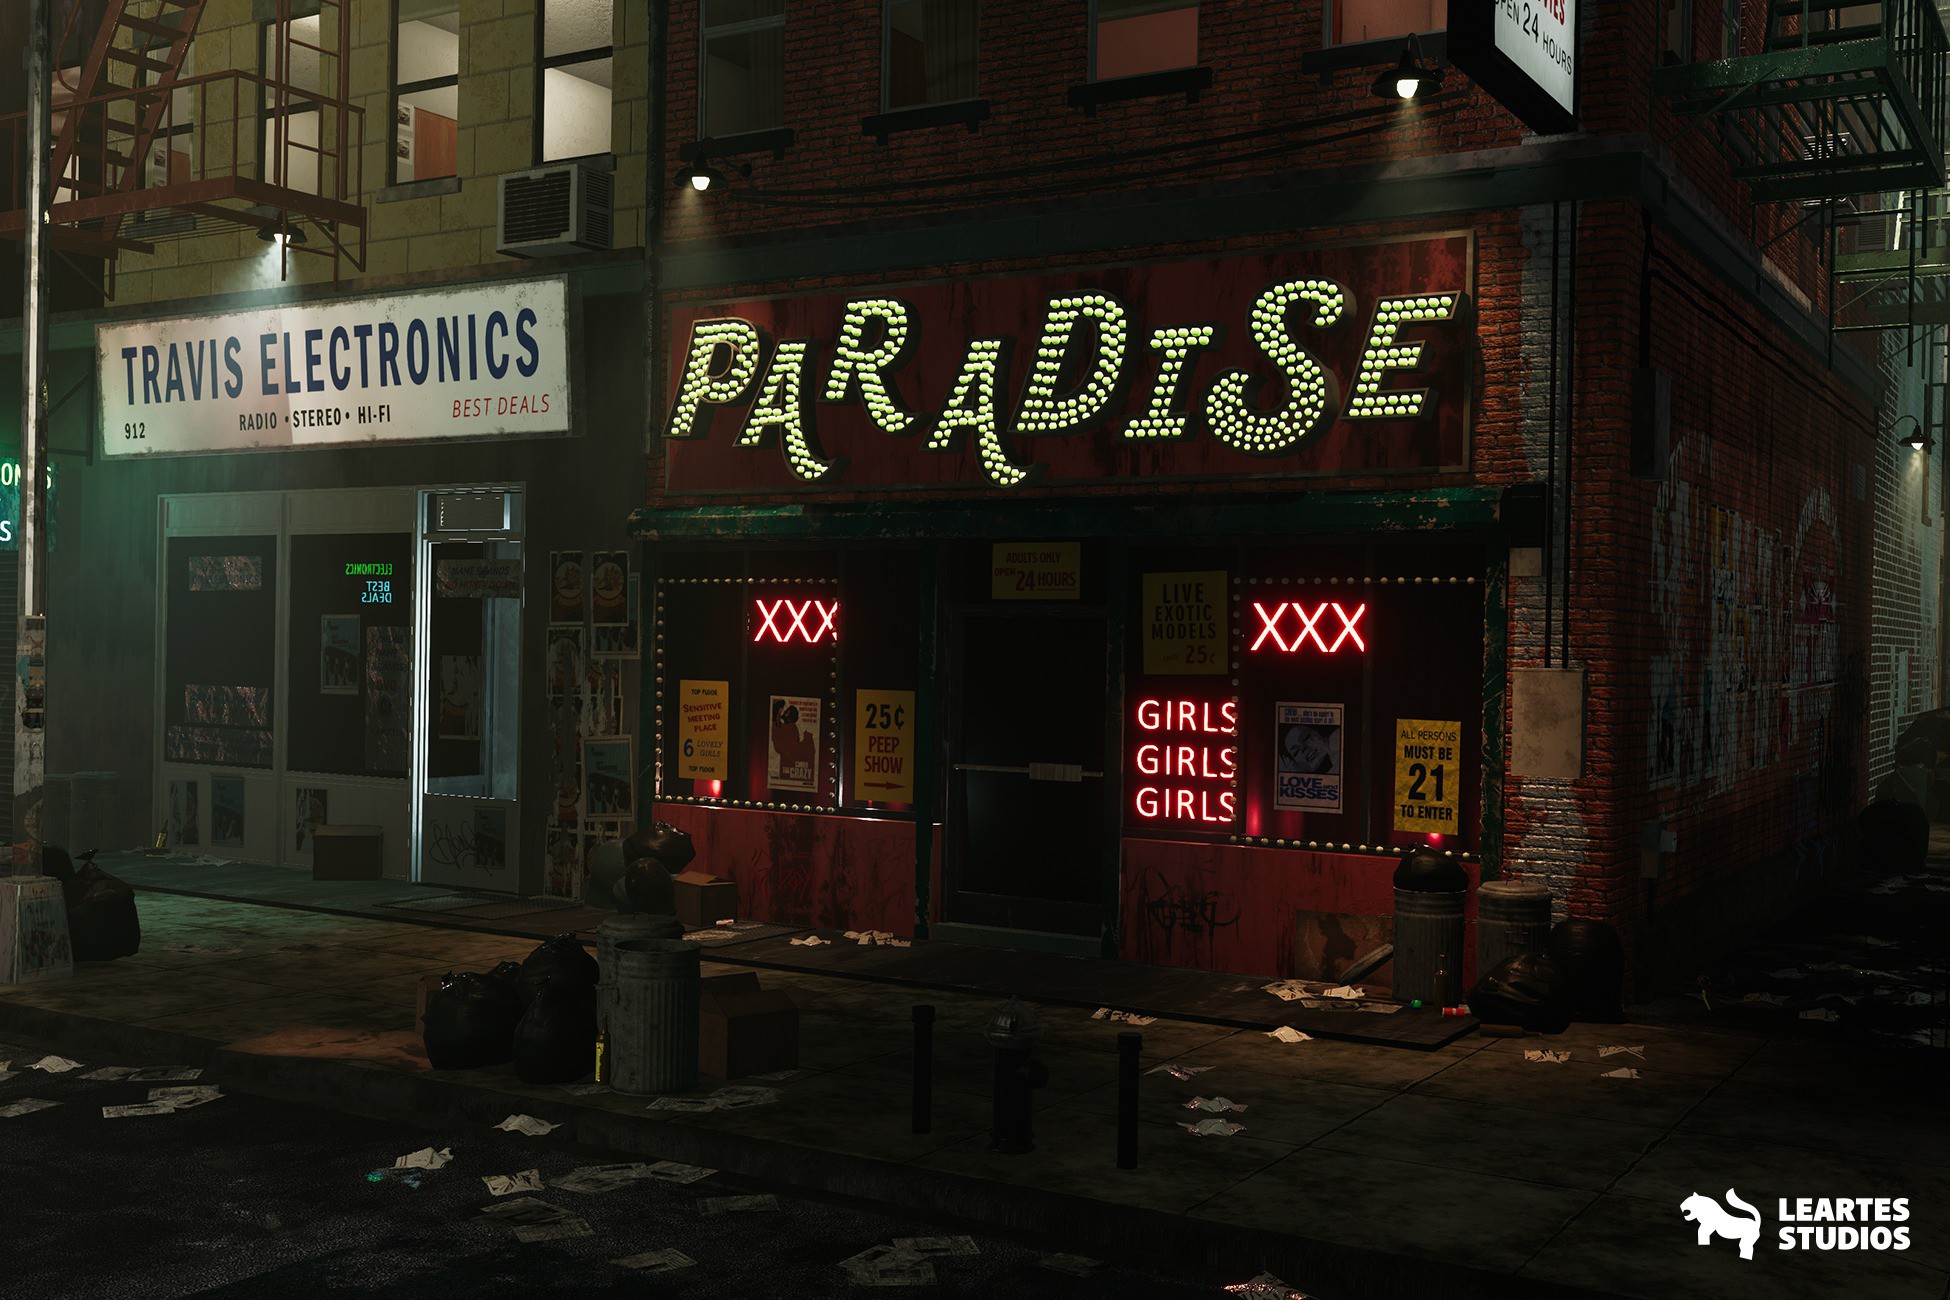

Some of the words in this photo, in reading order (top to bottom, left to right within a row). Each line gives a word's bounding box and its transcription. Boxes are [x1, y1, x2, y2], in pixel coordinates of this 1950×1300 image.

[1495, 0, 1520, 25] PEN
[1523, 2, 1539, 43] 24
[1543, 31, 1573, 75] HOURS
[122, 334, 245, 406] TRAVIS
[260, 307, 540, 396] ELECTRONICS
[669, 278, 1460, 487] PARADISE
[452, 396, 493, 418] BEST
[497, 393, 551, 416] DEALS
[239, 412, 277, 431] RADIO
[292, 408, 342, 428] STEREO
[358, 405, 391, 424] HI-FI
[124, 422, 147, 440] 912
[1006, 551, 1037, 564] ADULTS
[1040, 551, 1062, 564] ONLY
[994, 567, 1016, 577] OPEN
[1015, 570, 1036, 591] 24
[1038, 571, 1076, 587] HOURS
[1162, 583, 1204, 603] LIVE
[754, 599, 838, 643] XXX
[1155, 604, 1213, 622] EXOTIC
[1151, 622, 1217, 640] MODELS
[1250, 602, 1365, 653] XXX
[691, 688, 701, 696] TOP
[702, 688, 718, 697] FLOOR
[683, 702, 722, 713] SENSITIVE
[865, 703, 906, 731] 25¢
[1137, 700, 1236, 734] GIRLS
[687, 713, 721, 723] MEETING
[693, 723, 717, 733] PLACE
[1401, 729, 1417, 741] ALL
[1418, 730, 1458, 743] PERSONS
[683, 738, 694, 758] 6
[697, 740, 723, 749] LOVELY
[700, 749, 721, 758] GIRLS
[868, 736, 900, 755] PEEP
[1404, 745, 1435, 761] MUST
[1438, 746, 1453, 762] BE
[864, 755, 904, 775] SHOW
[1136, 745, 1235, 779] GIRLS
[790, 767, 812, 780] CRAZY
[1280, 775, 1323, 789] LOVE
[1408, 764, 1445, 802] 21
[1279, 787, 1339, 801] KISSES
[1135, 786, 1234, 822] GIRLS
[1400, 804, 1415, 820] TO
[1418, 805, 1453, 822] ENTER
